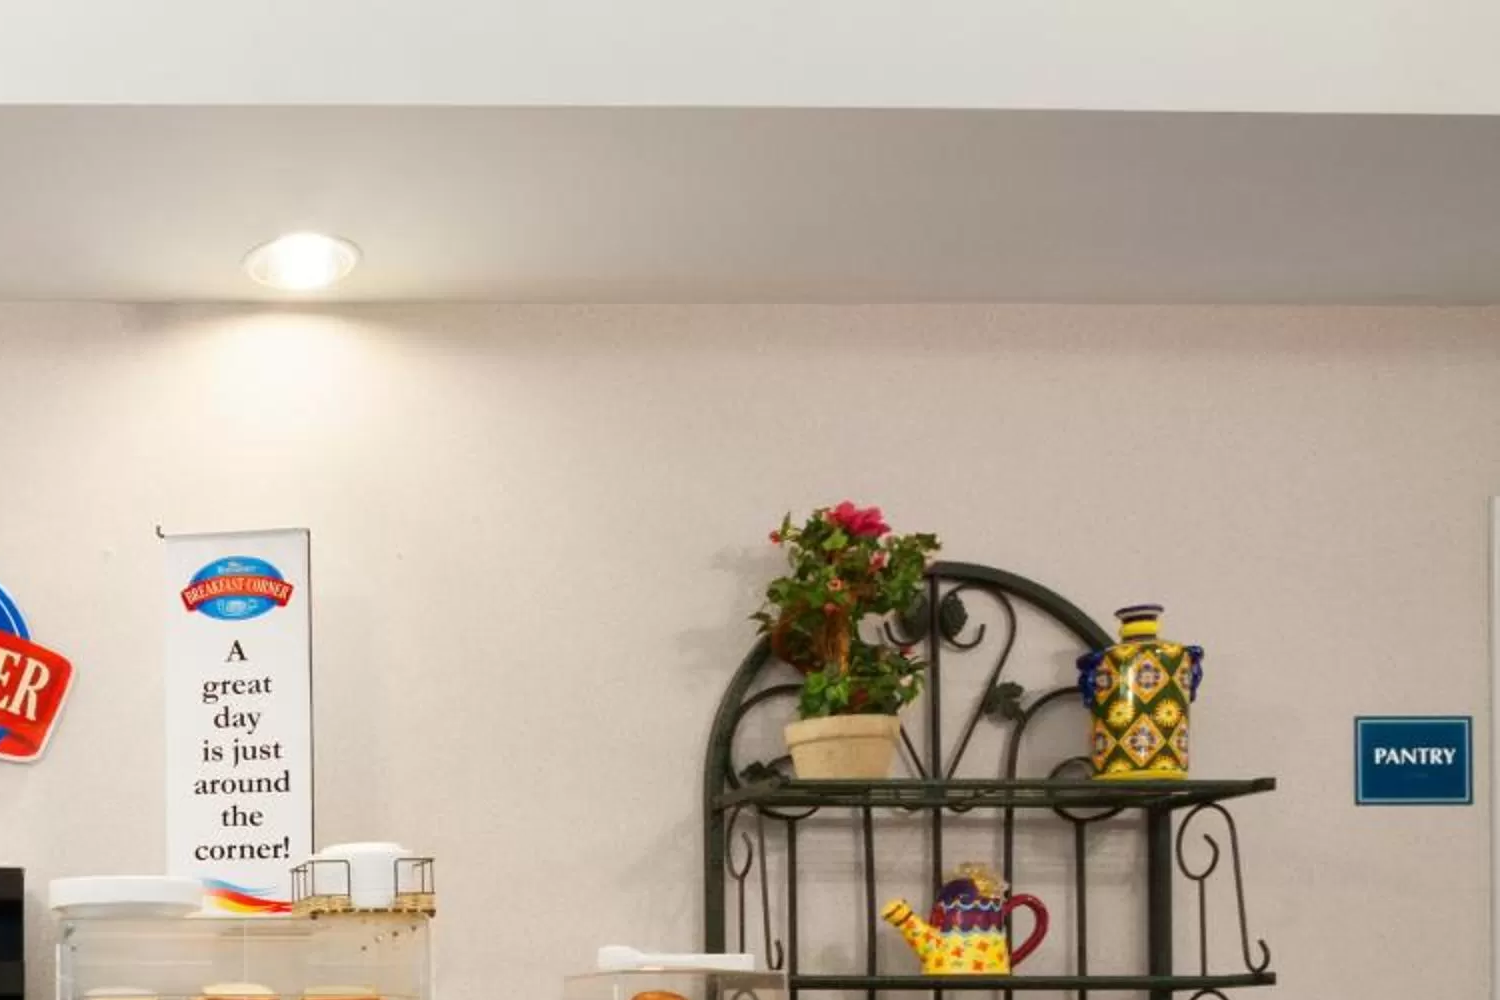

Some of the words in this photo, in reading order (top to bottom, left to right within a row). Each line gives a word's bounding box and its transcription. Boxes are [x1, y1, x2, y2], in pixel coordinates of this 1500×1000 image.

[183, 577, 245, 605] BREAKFAST
[245, 577, 291, 600] CORNER
[225, 639, 248, 662] A
[202, 674, 274, 703] great
[213, 706, 262, 735] day
[202, 738, 224, 762] is
[232, 738, 284, 767] just
[1373, 747, 1457, 766] PANTRY
[194, 770, 291, 795] around
[221, 805, 265, 828] the
[195, 837, 291, 861] corner!
